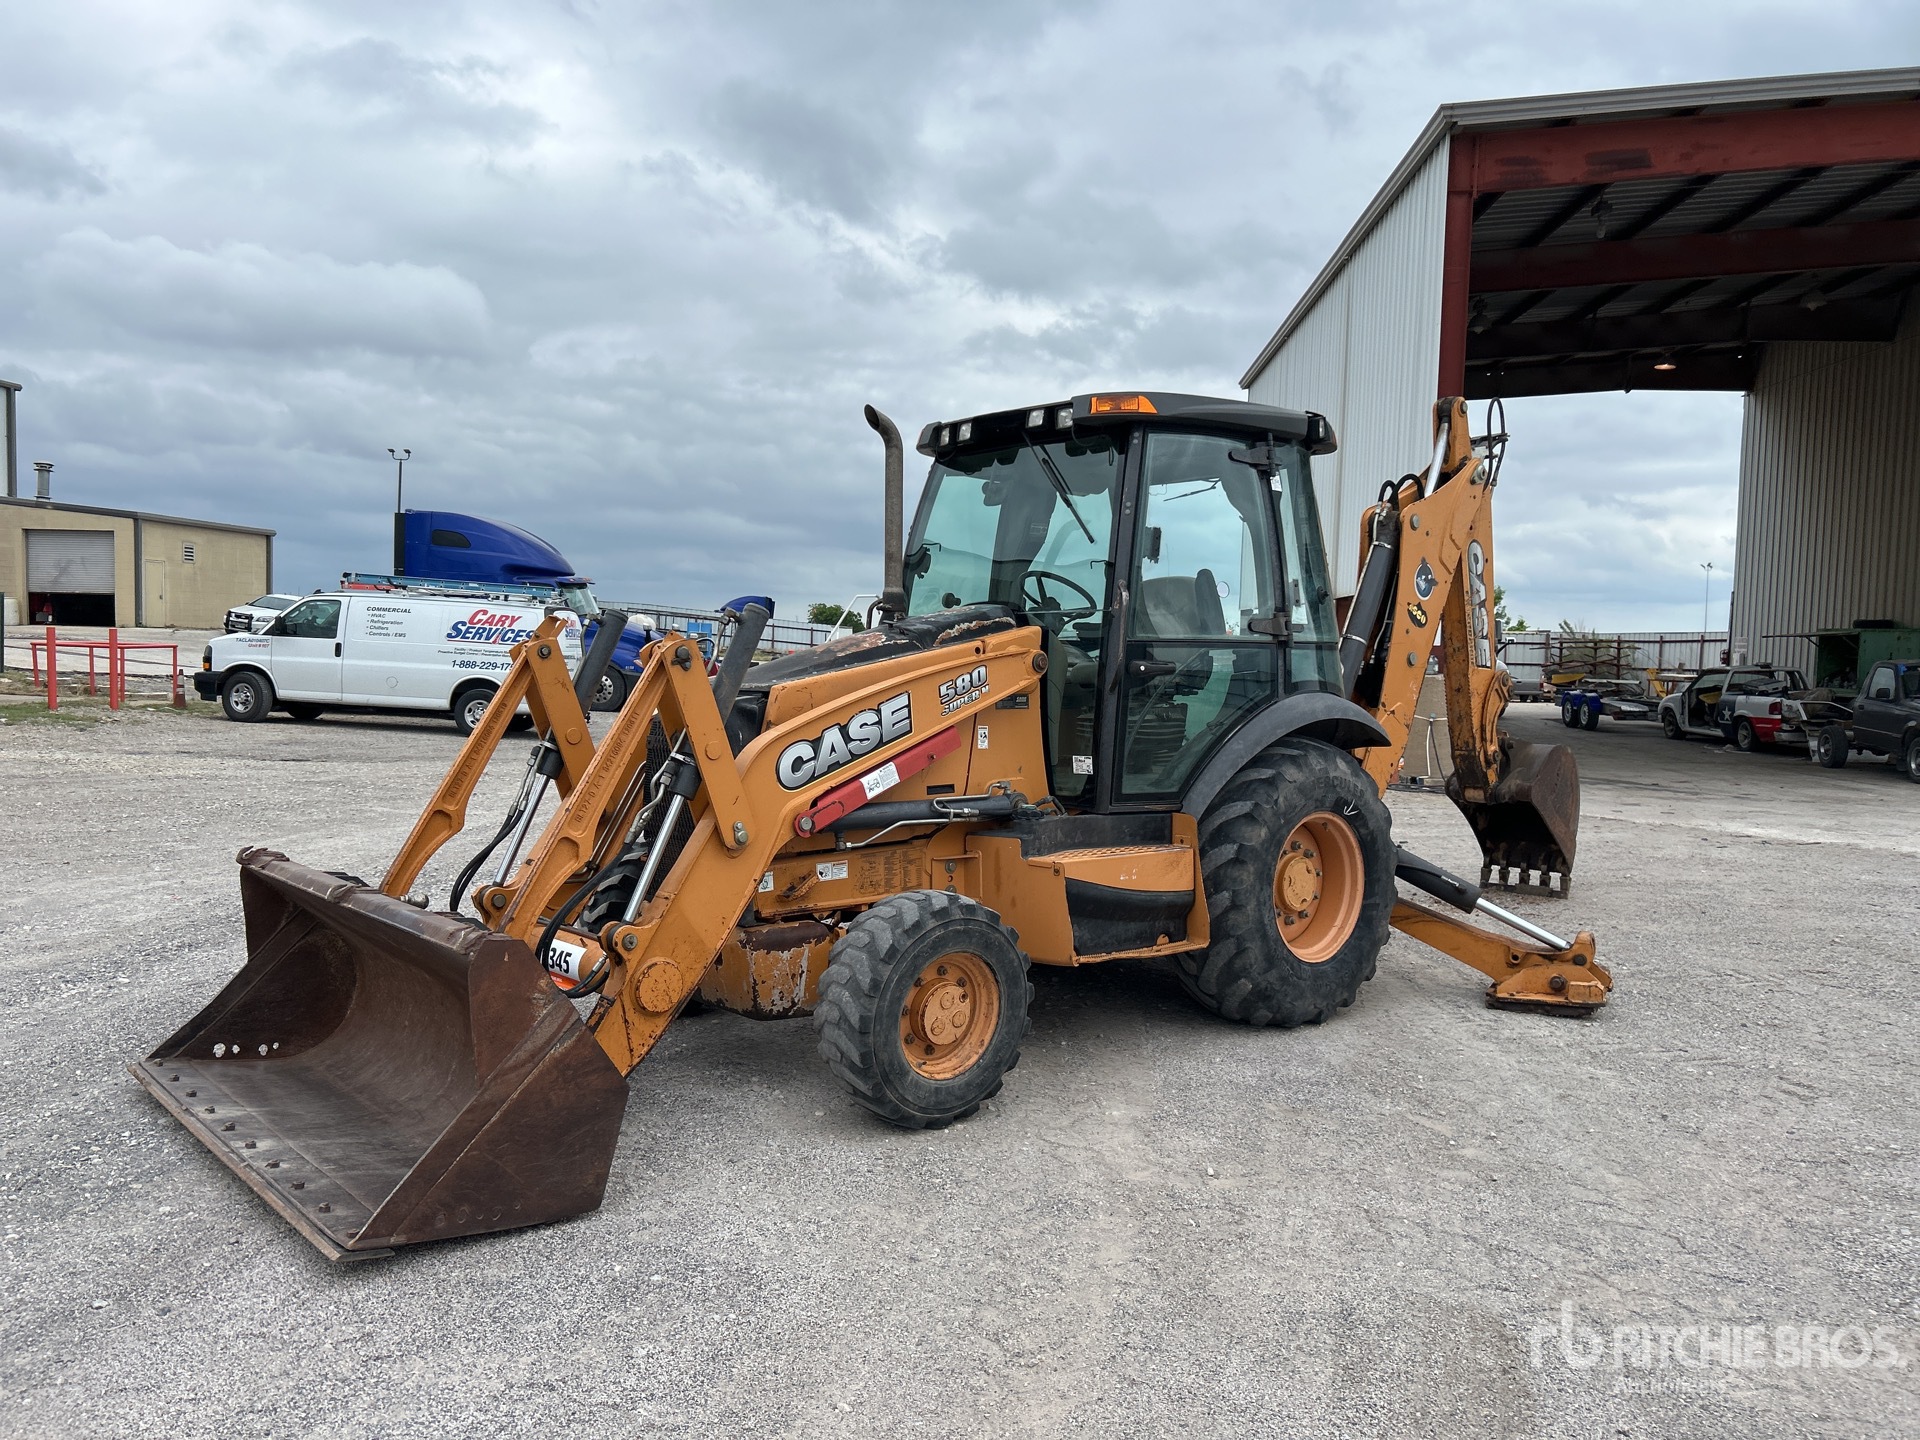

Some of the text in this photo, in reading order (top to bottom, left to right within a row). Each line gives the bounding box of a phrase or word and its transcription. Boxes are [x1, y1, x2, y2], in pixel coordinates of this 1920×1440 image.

[468, 609, 523, 628] CARY
[1467, 540, 1492, 668] CASE
[938, 664, 988, 705] 580
[941, 689, 980, 716] SUPER
[777, 691, 912, 790] CASE
[549, 947, 573, 975] 345
